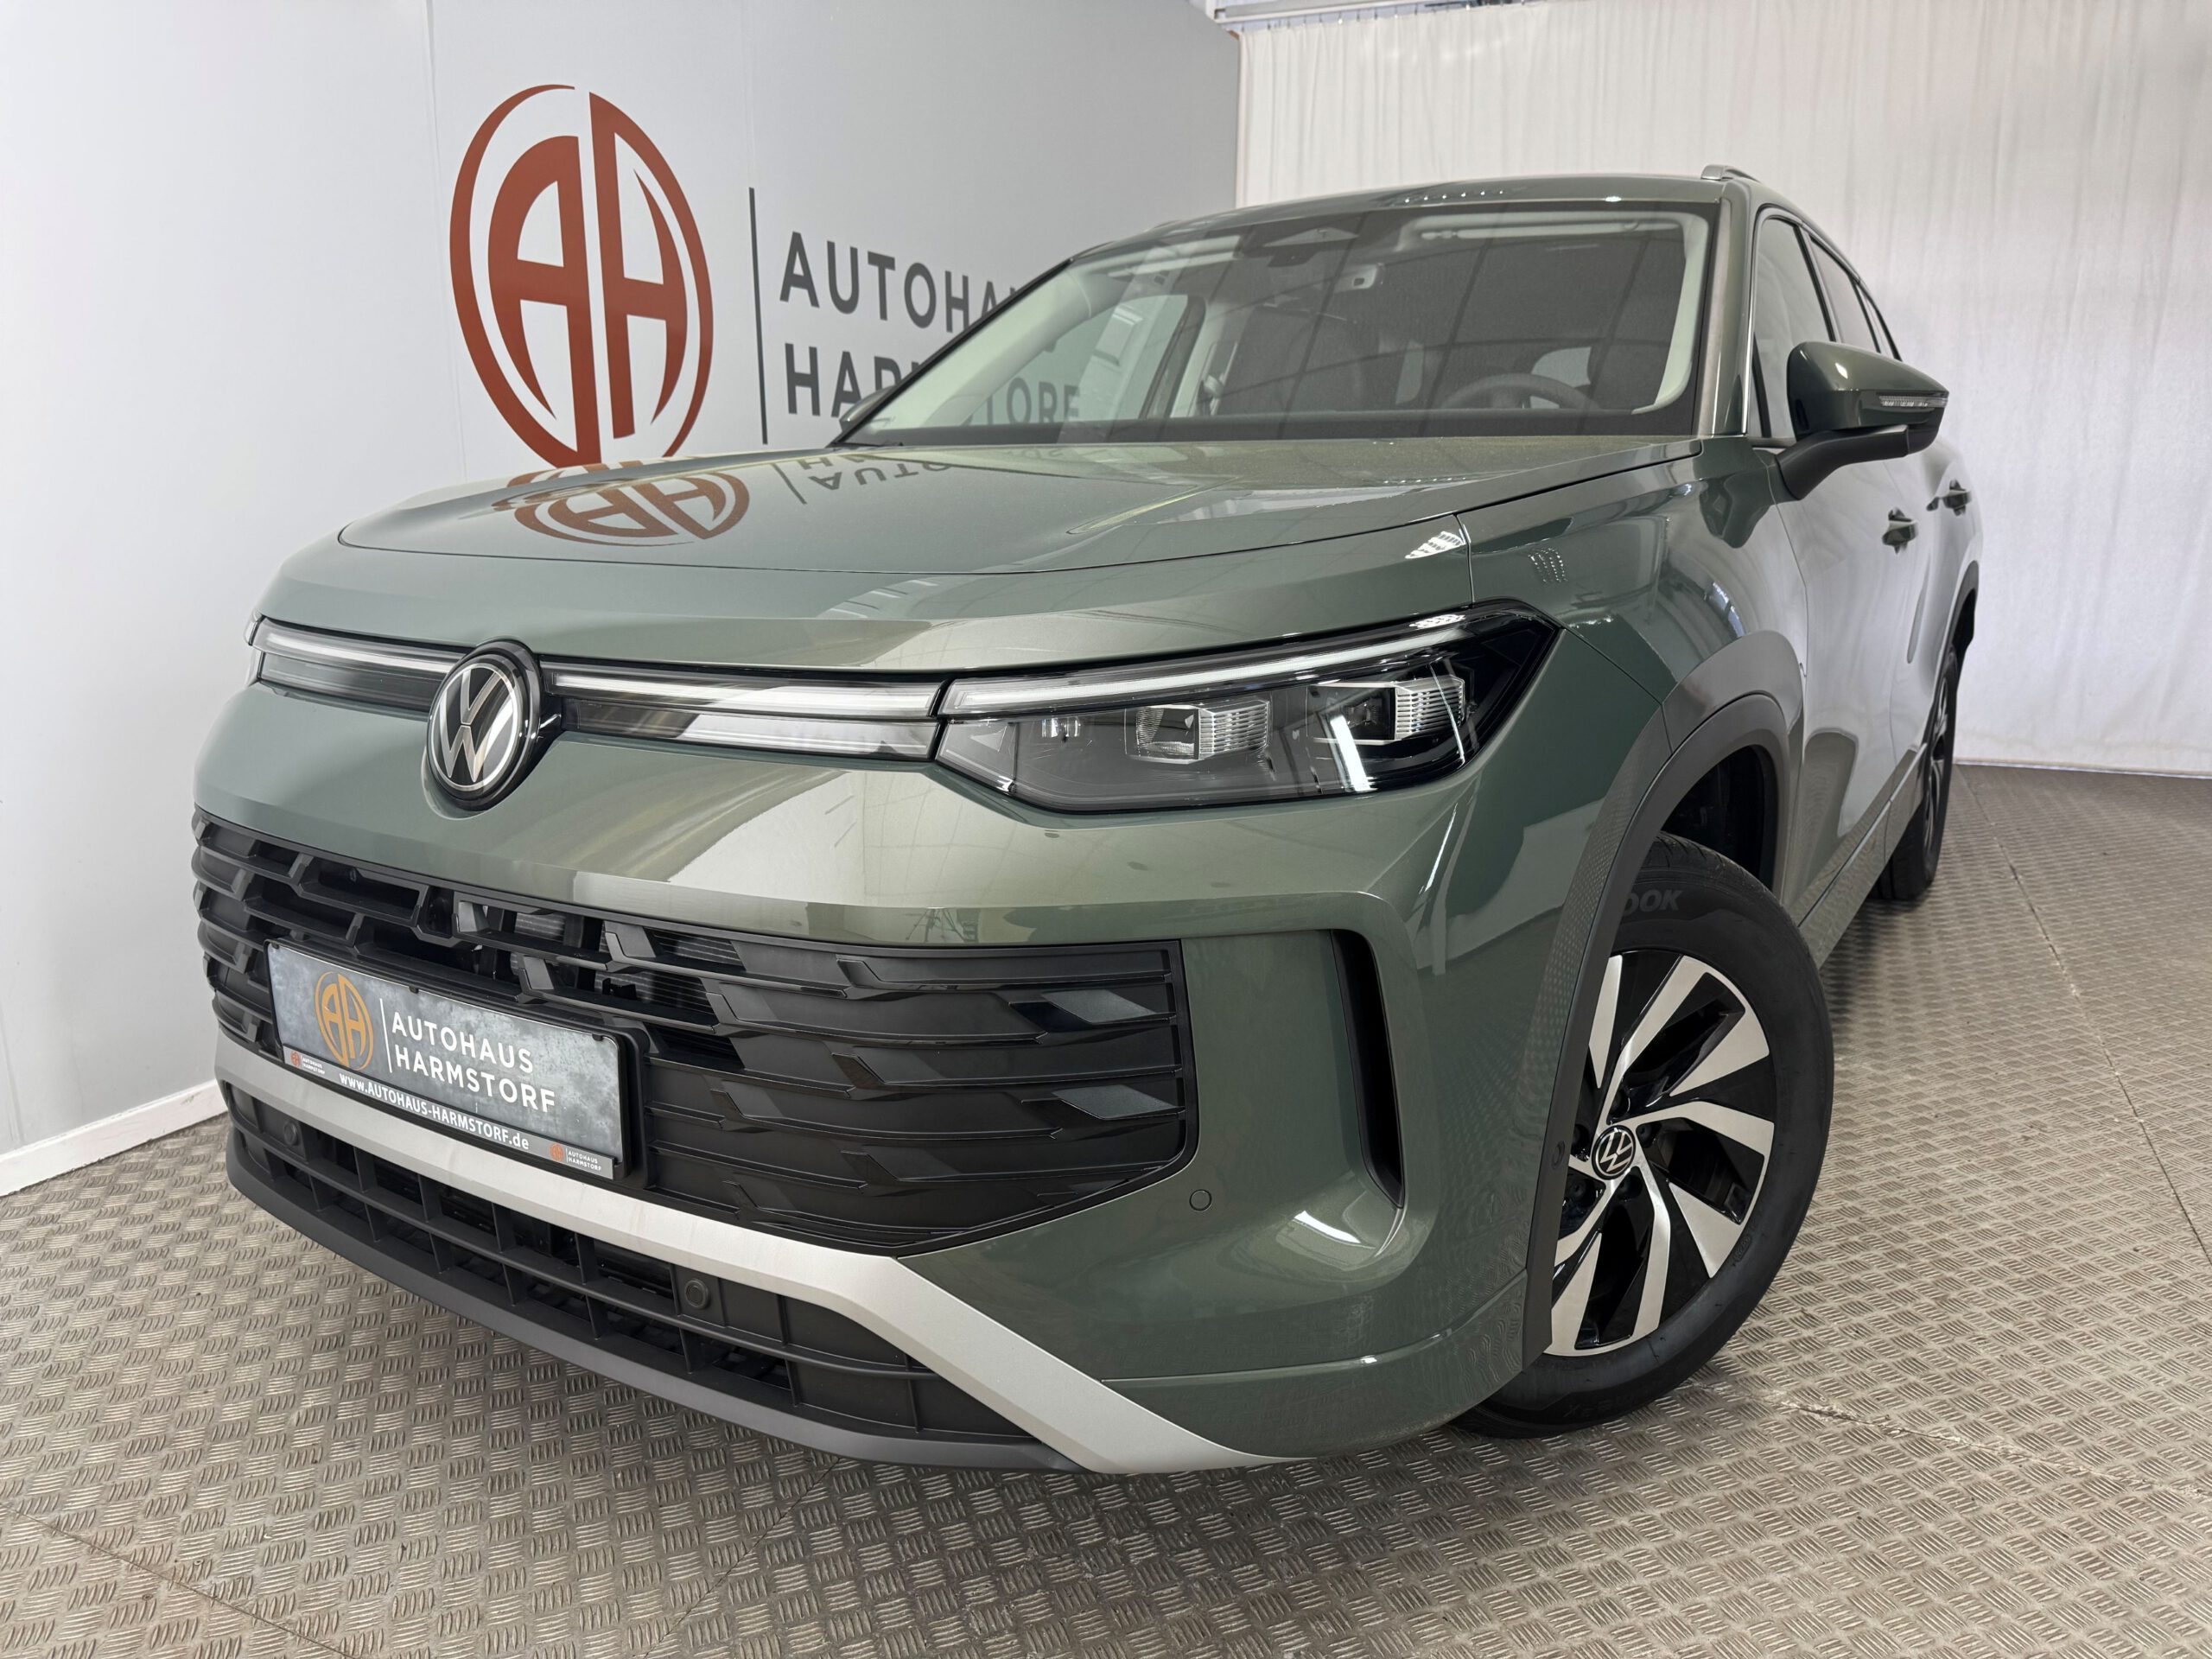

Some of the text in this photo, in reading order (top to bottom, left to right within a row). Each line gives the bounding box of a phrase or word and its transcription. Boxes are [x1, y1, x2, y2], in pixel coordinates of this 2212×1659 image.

[391, 1011, 534, 1074] AUTOHAUS
[339, 1073, 530, 1150] www.AUTOHAUS-HARMSTORF.de
[394, 1044, 556, 1113] HARMSTORF
[568, 1149, 599, 1164] AUTOHAUS
